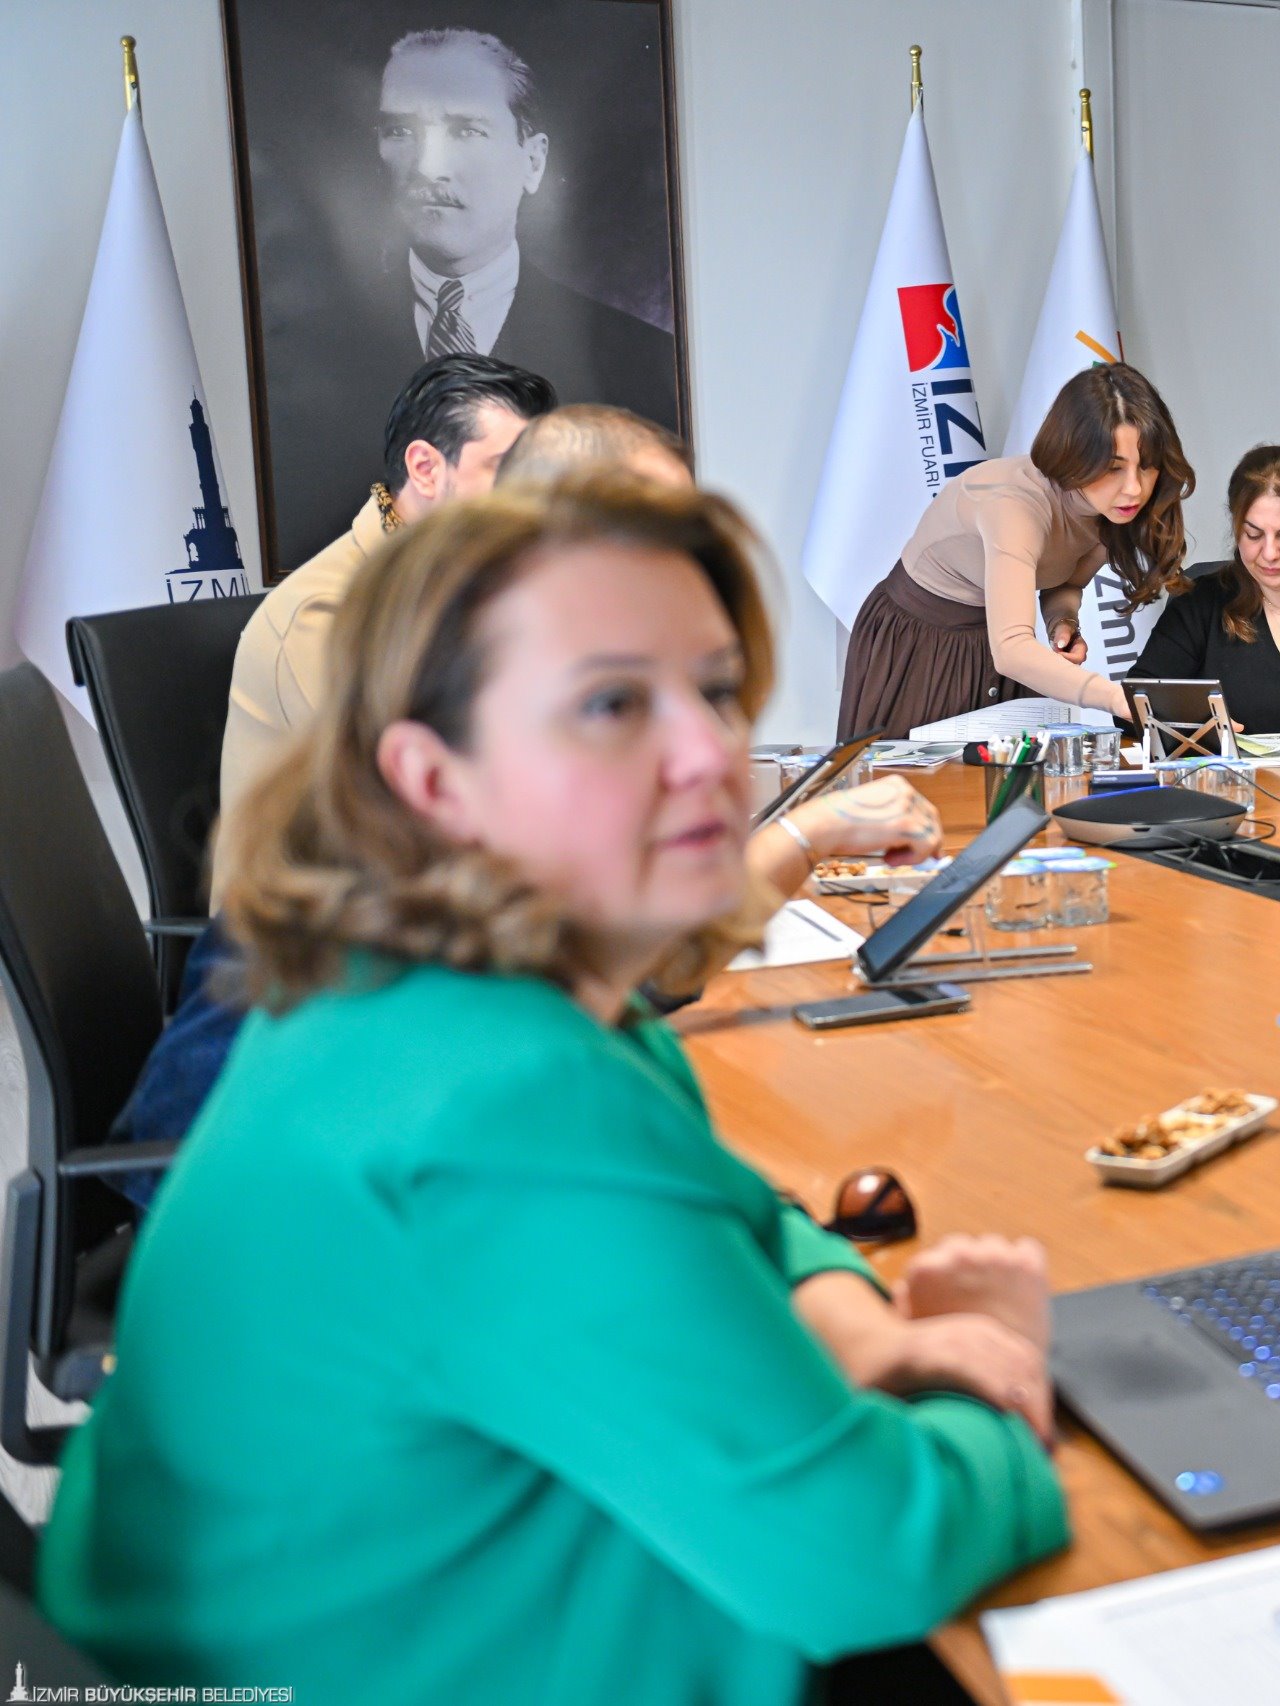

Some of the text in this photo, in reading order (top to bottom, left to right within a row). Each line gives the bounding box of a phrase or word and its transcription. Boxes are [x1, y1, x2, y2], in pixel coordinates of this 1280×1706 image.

[911, 382, 941, 487] İZMİR FUARI
[165, 573, 251, 604] İZMİ
